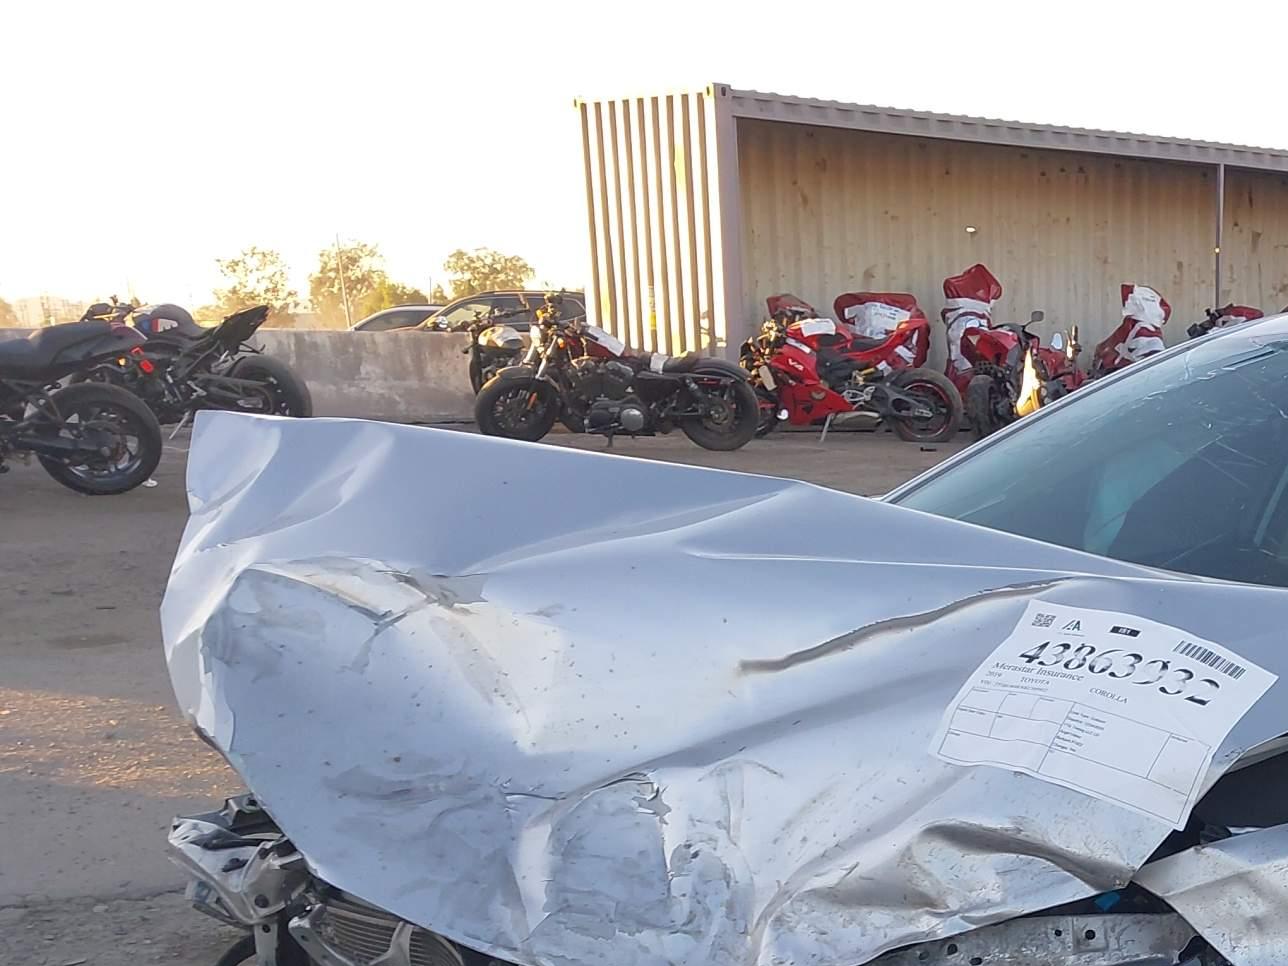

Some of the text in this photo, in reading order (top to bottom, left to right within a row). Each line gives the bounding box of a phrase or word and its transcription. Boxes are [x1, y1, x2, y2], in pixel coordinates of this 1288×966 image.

[992, 662, 1085, 681] Merastar Insurance
[1019, 641, 1220, 706] 43863932
[1020, 676, 1050, 685] TOYOTA
[1089, 686, 1128, 704] COROLLA
